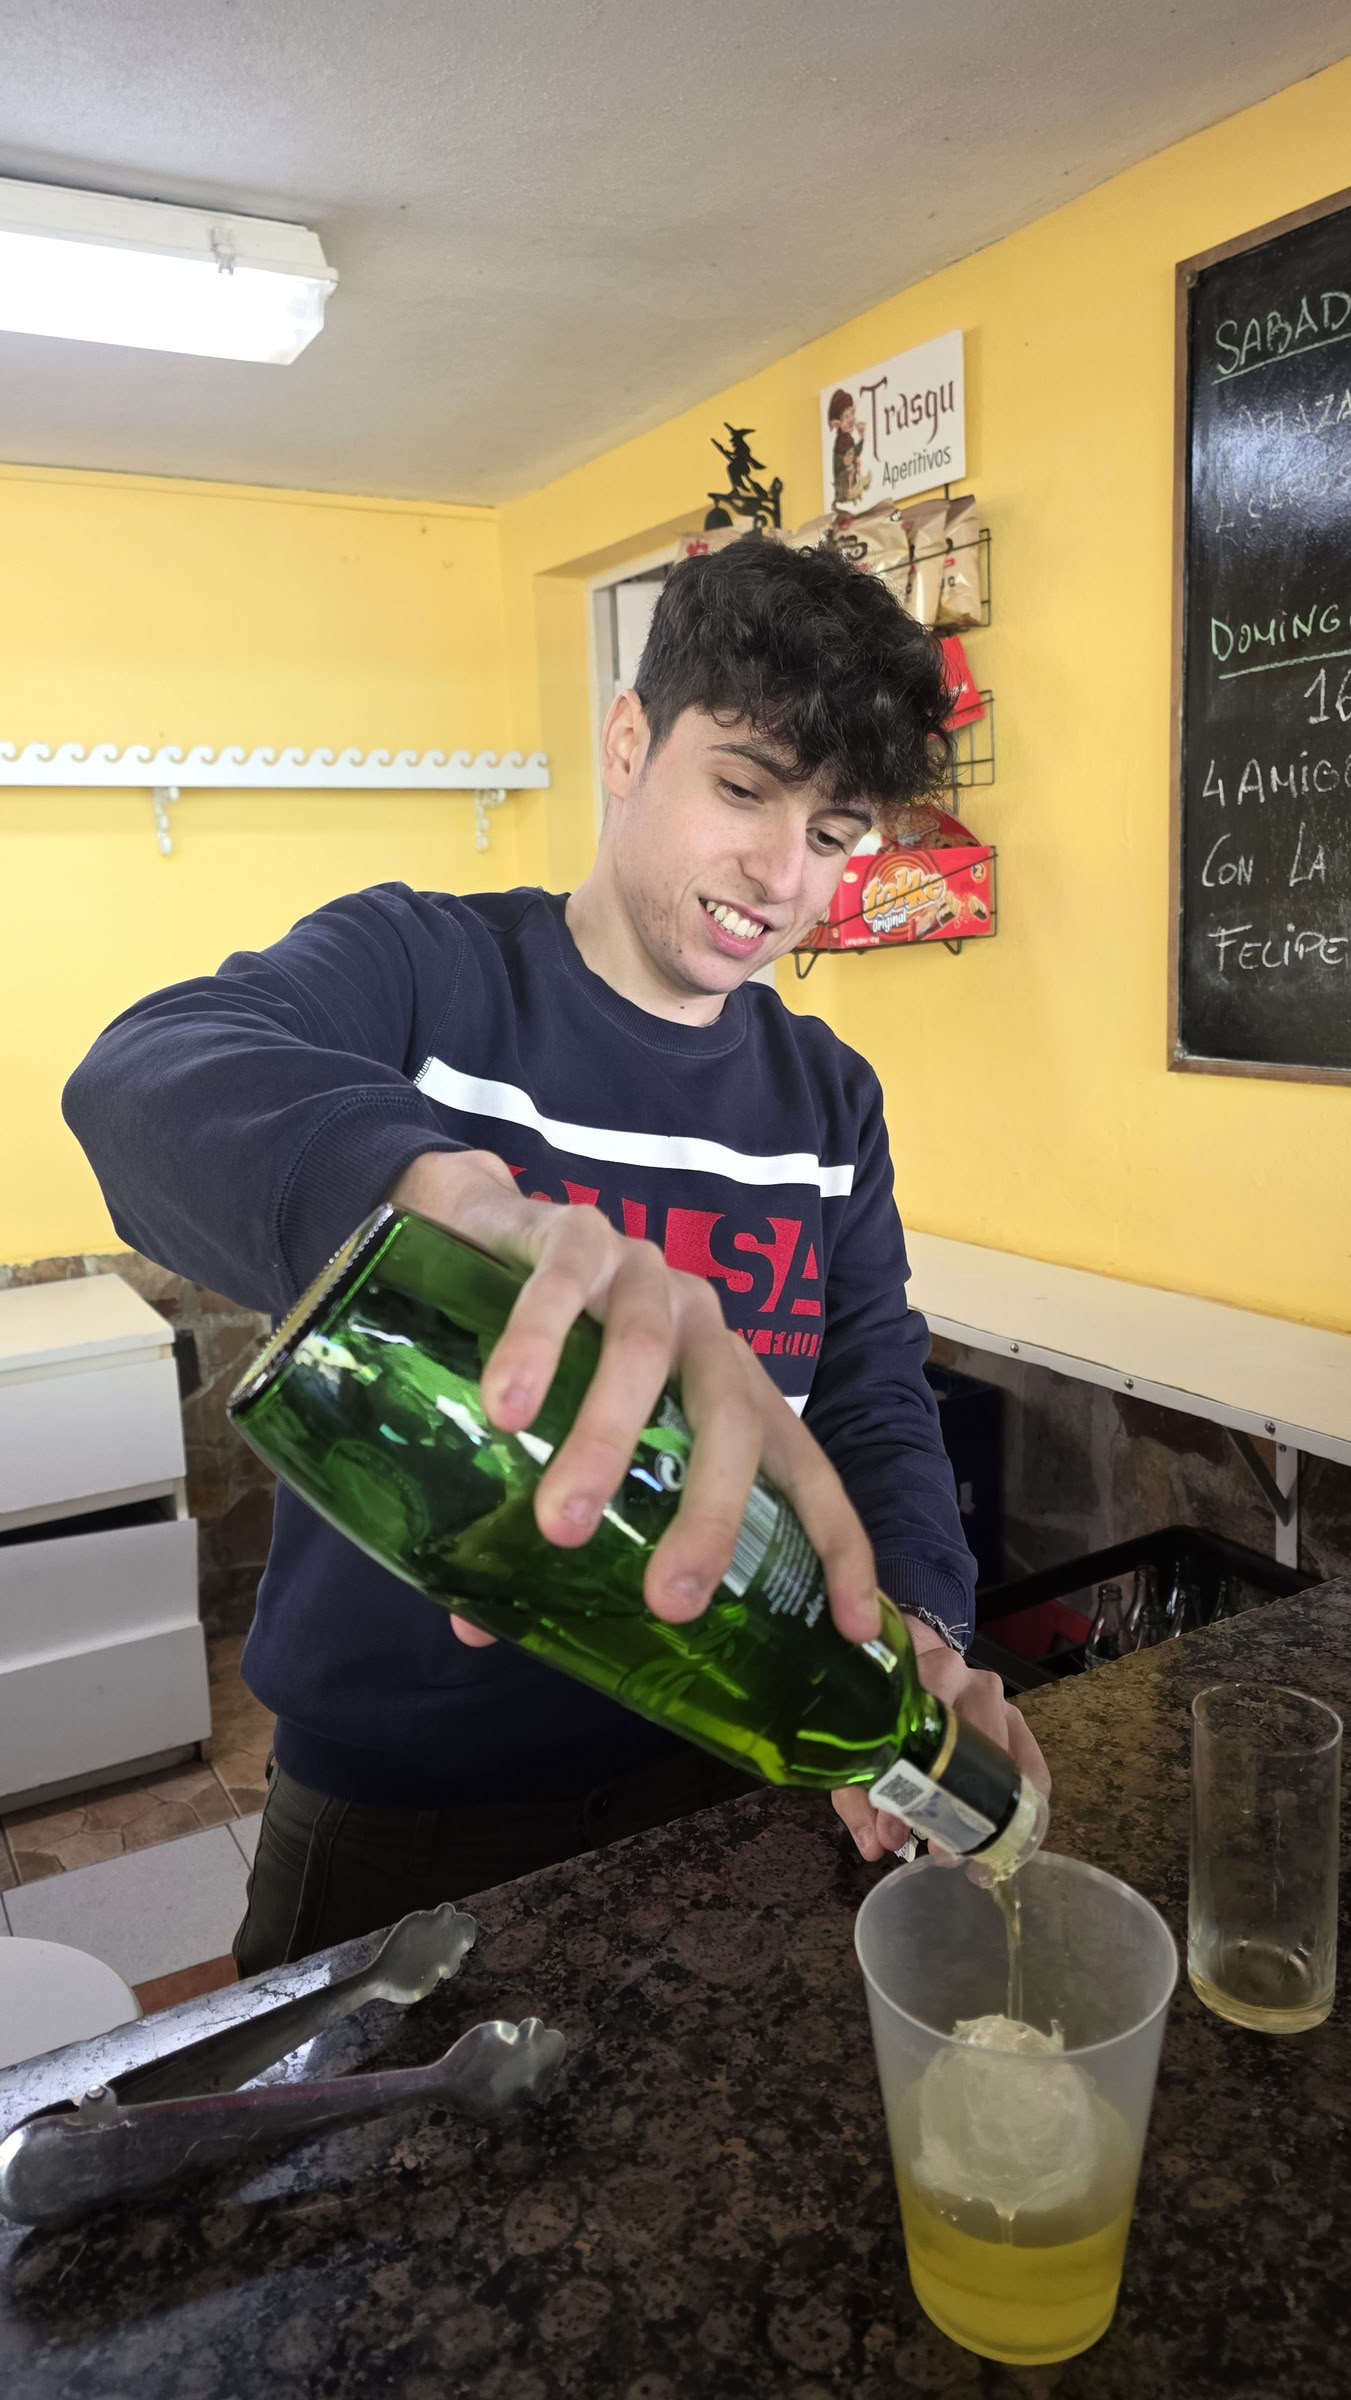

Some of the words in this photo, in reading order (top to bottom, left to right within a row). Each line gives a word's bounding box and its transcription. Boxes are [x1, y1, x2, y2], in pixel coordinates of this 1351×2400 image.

[859, 376, 955, 463] Trasgu
[882, 446, 951, 488] Aperitivos
[1212, 603, 1351, 660] DOMING
[1202, 834, 1254, 887] CON
[1289, 821, 1325, 887] LA
[1208, 922, 1348, 971] FELIPE
